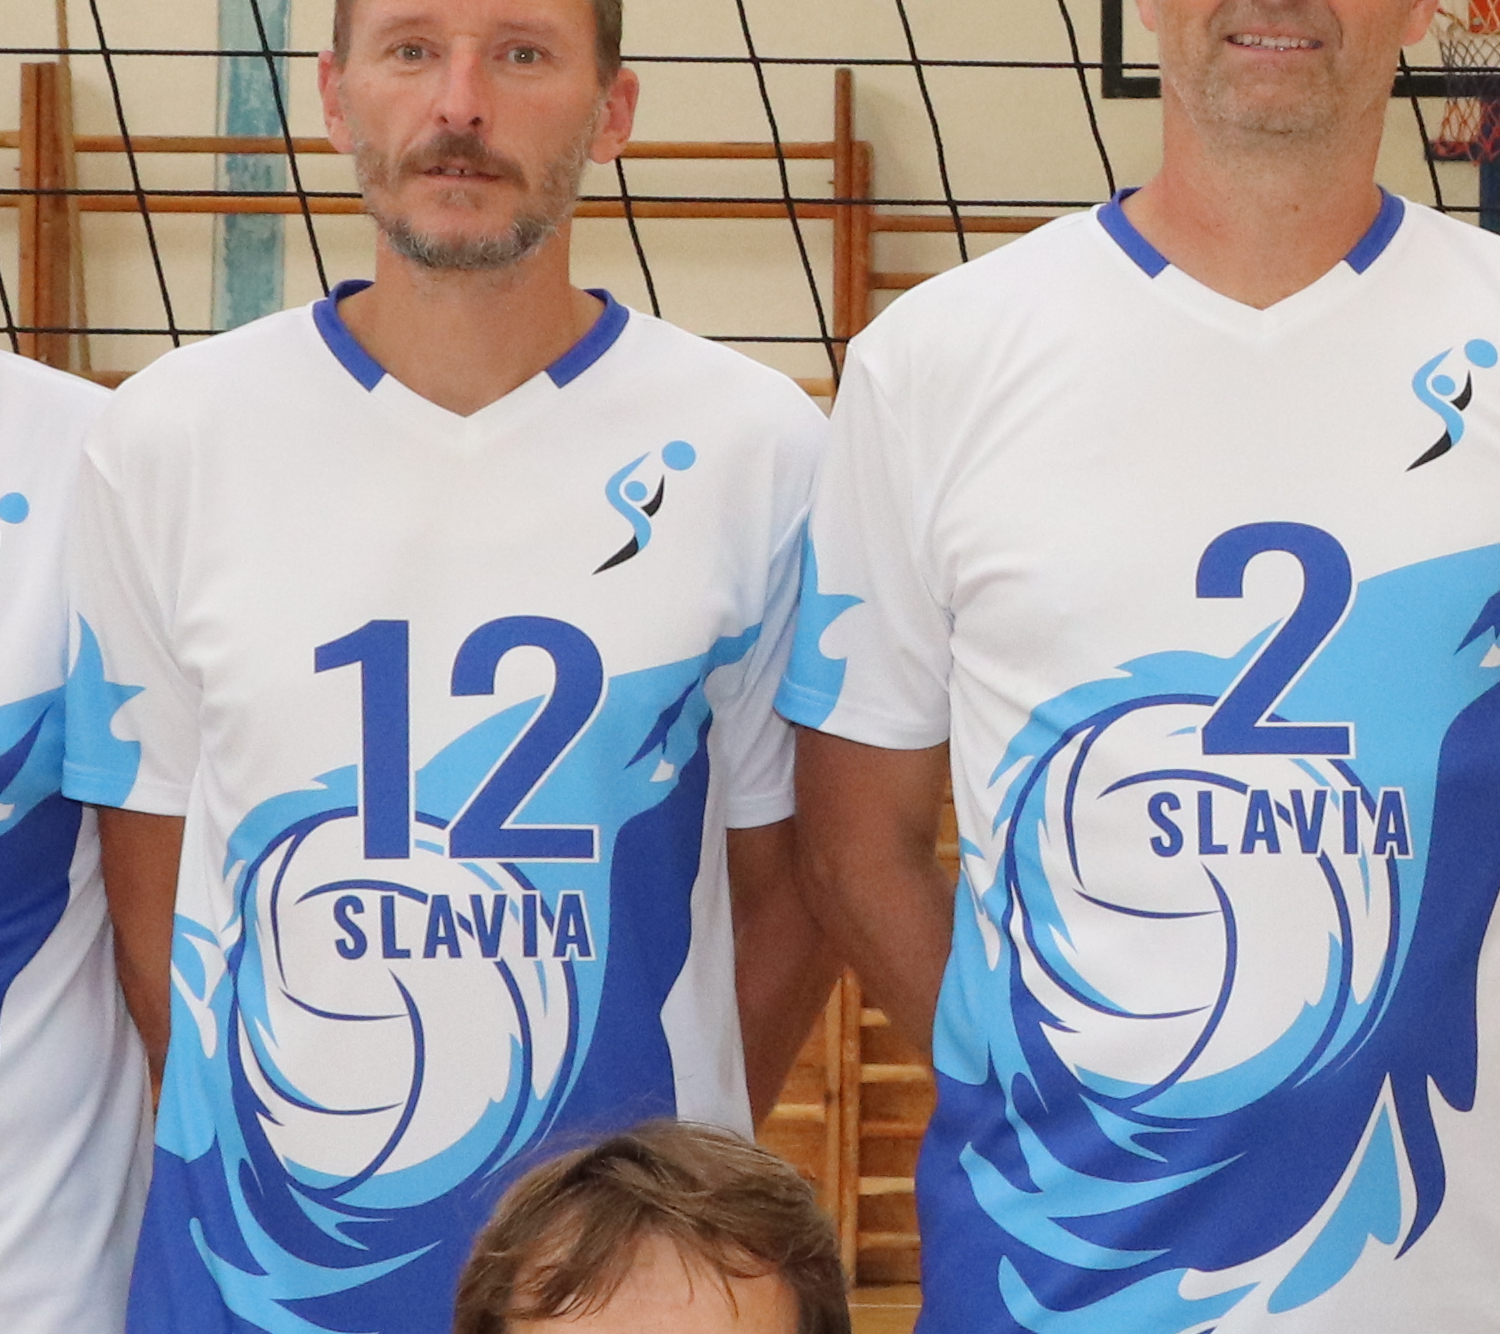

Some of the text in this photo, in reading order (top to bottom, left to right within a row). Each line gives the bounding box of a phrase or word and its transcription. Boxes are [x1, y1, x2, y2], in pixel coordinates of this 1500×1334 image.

[1195, 522, 1353, 756] 2
[314, 616, 604, 861] 12
[1148, 789, 1412, 858] SLAVIA
[334, 893, 593, 960] SLAVIA
